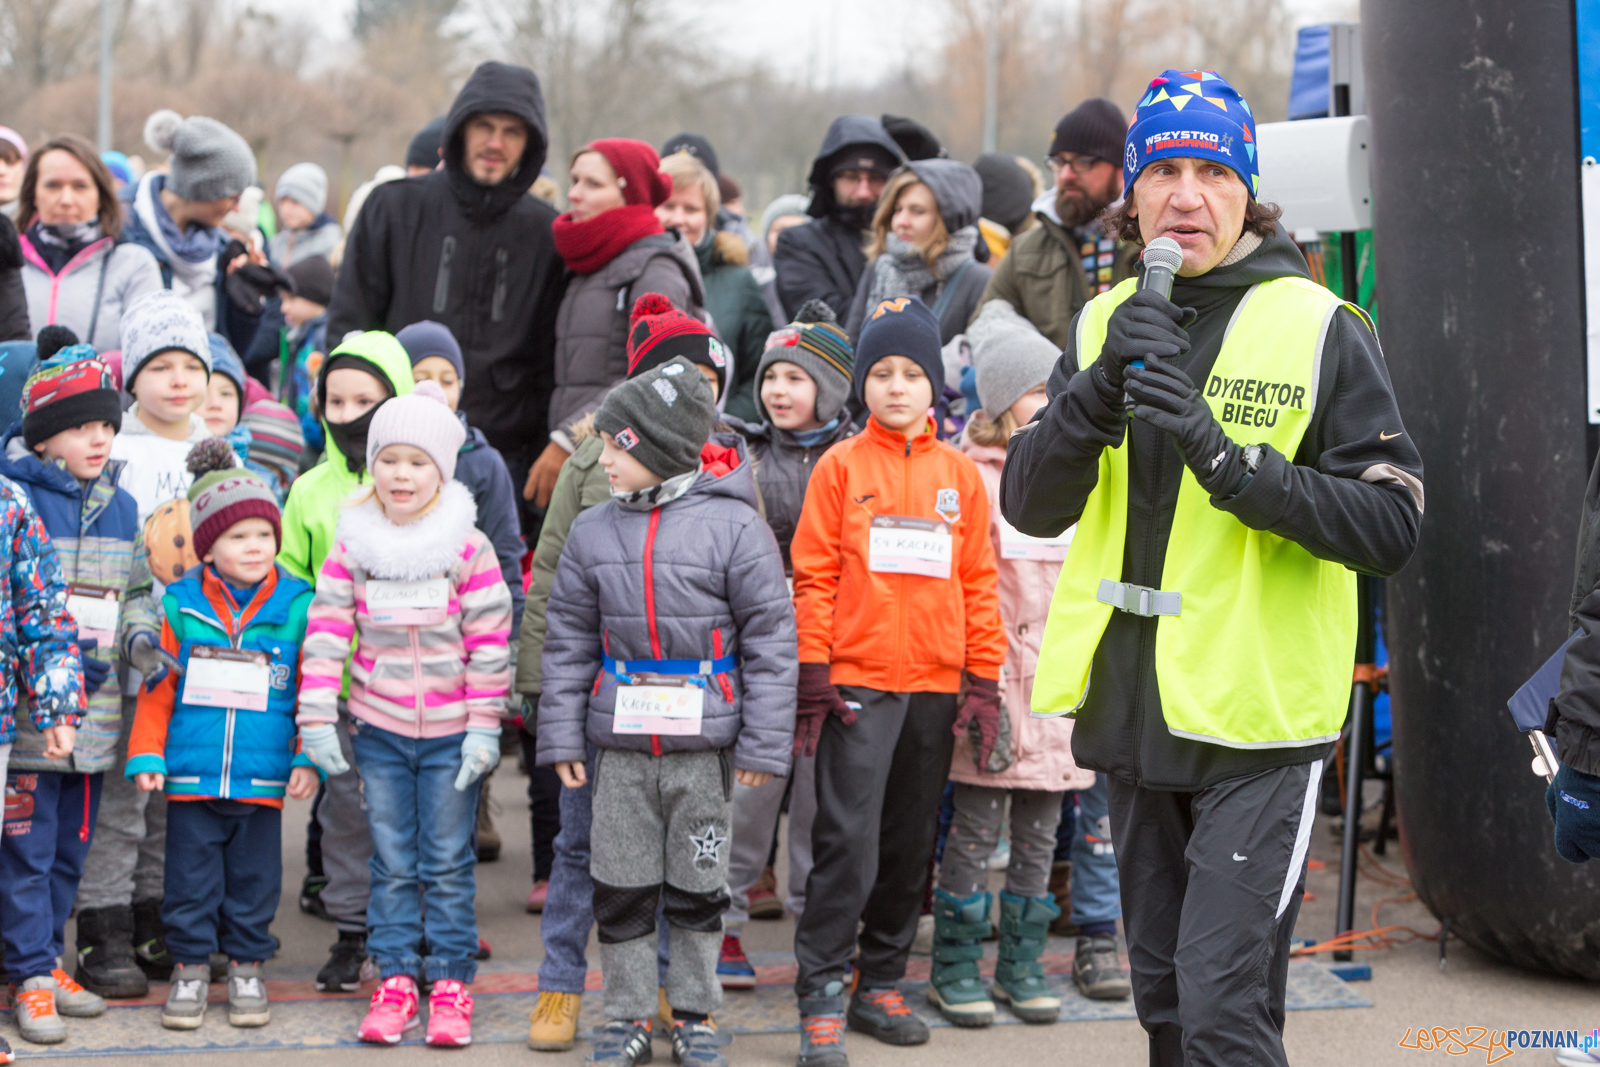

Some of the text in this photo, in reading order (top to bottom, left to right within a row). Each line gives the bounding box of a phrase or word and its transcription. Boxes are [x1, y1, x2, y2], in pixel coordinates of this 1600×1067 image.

[1145, 130, 1219, 146] WSZYSTKO
[1206, 375, 1306, 410] DYREKTOR
[1221, 402, 1279, 428] BIEGU
[896, 538, 945, 554] KACPER
[621, 694, 661, 712] KACPER
